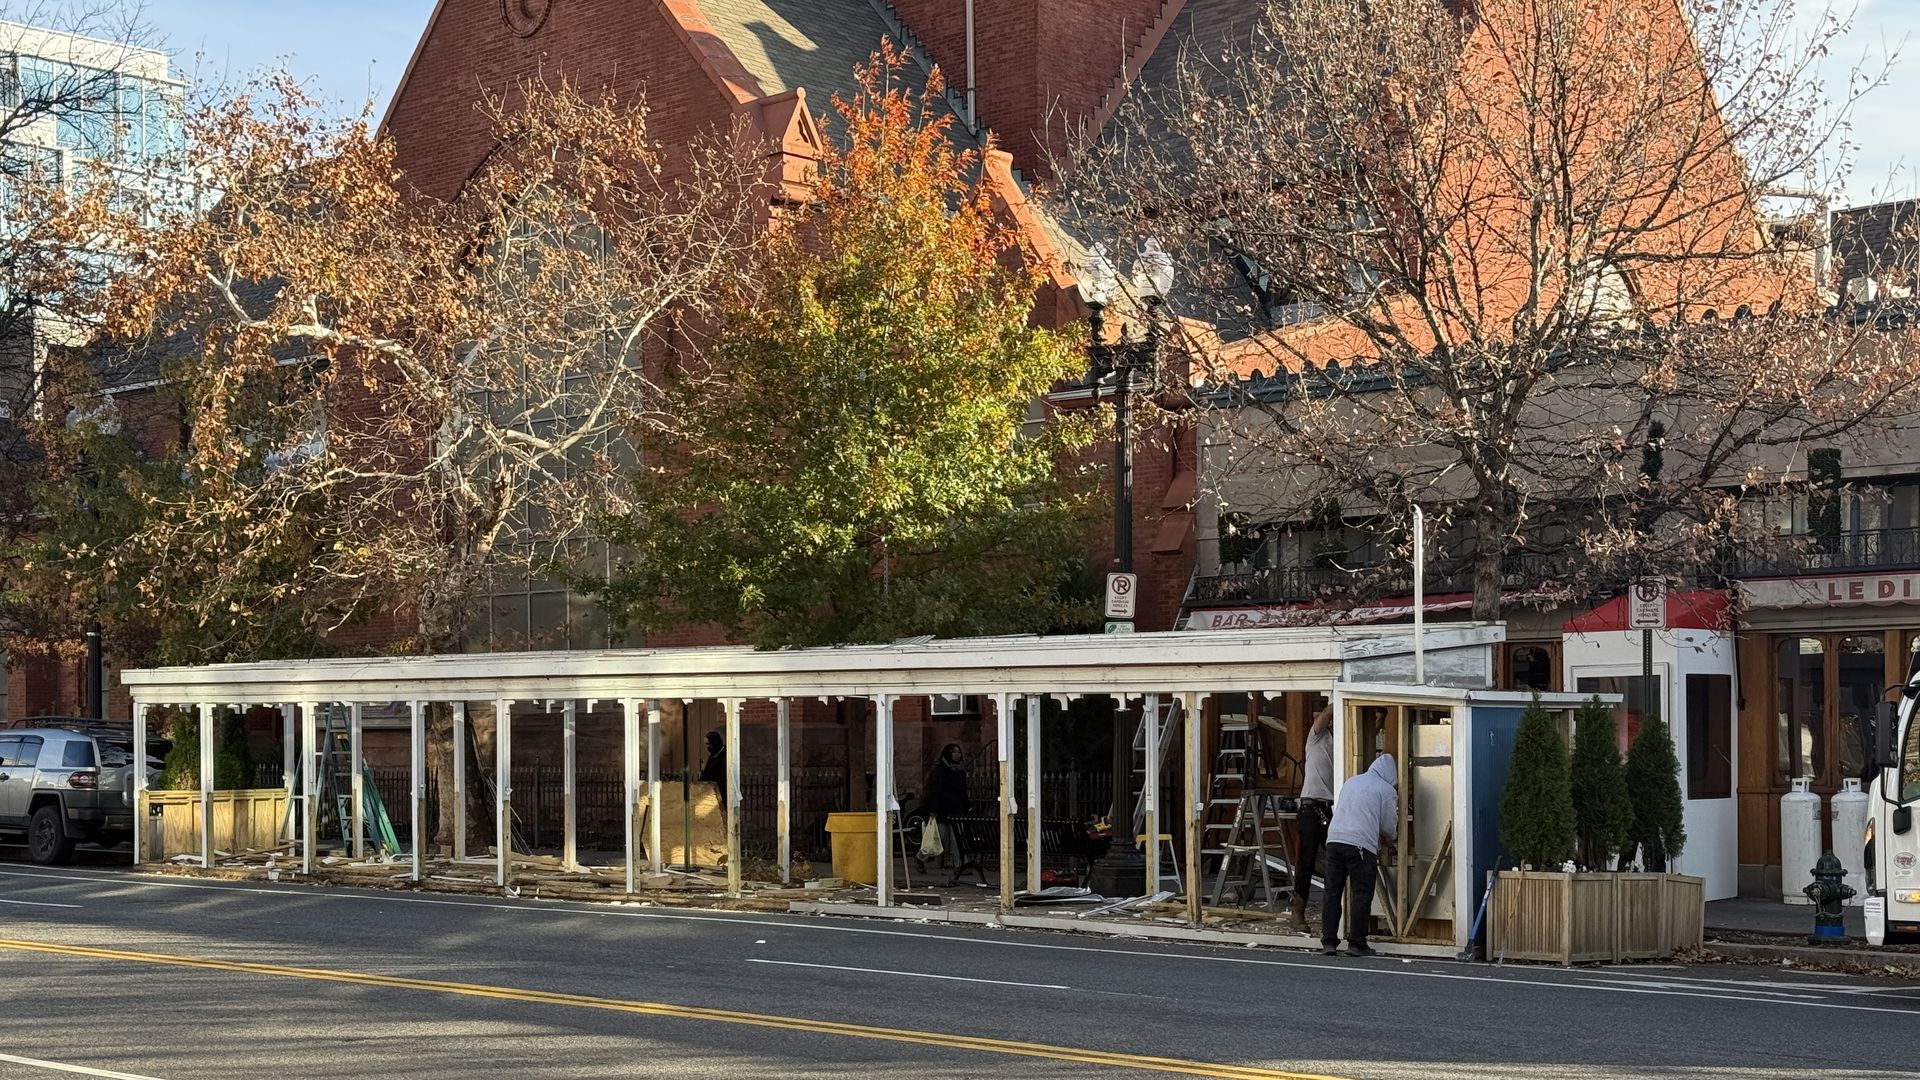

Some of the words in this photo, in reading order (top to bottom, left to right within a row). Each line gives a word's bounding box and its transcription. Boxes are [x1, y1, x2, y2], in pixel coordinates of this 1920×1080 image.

[1828, 581, 1864, 600] LE
[1878, 579, 1911, 598] DI
[1211, 613, 1249, 627] BAR
